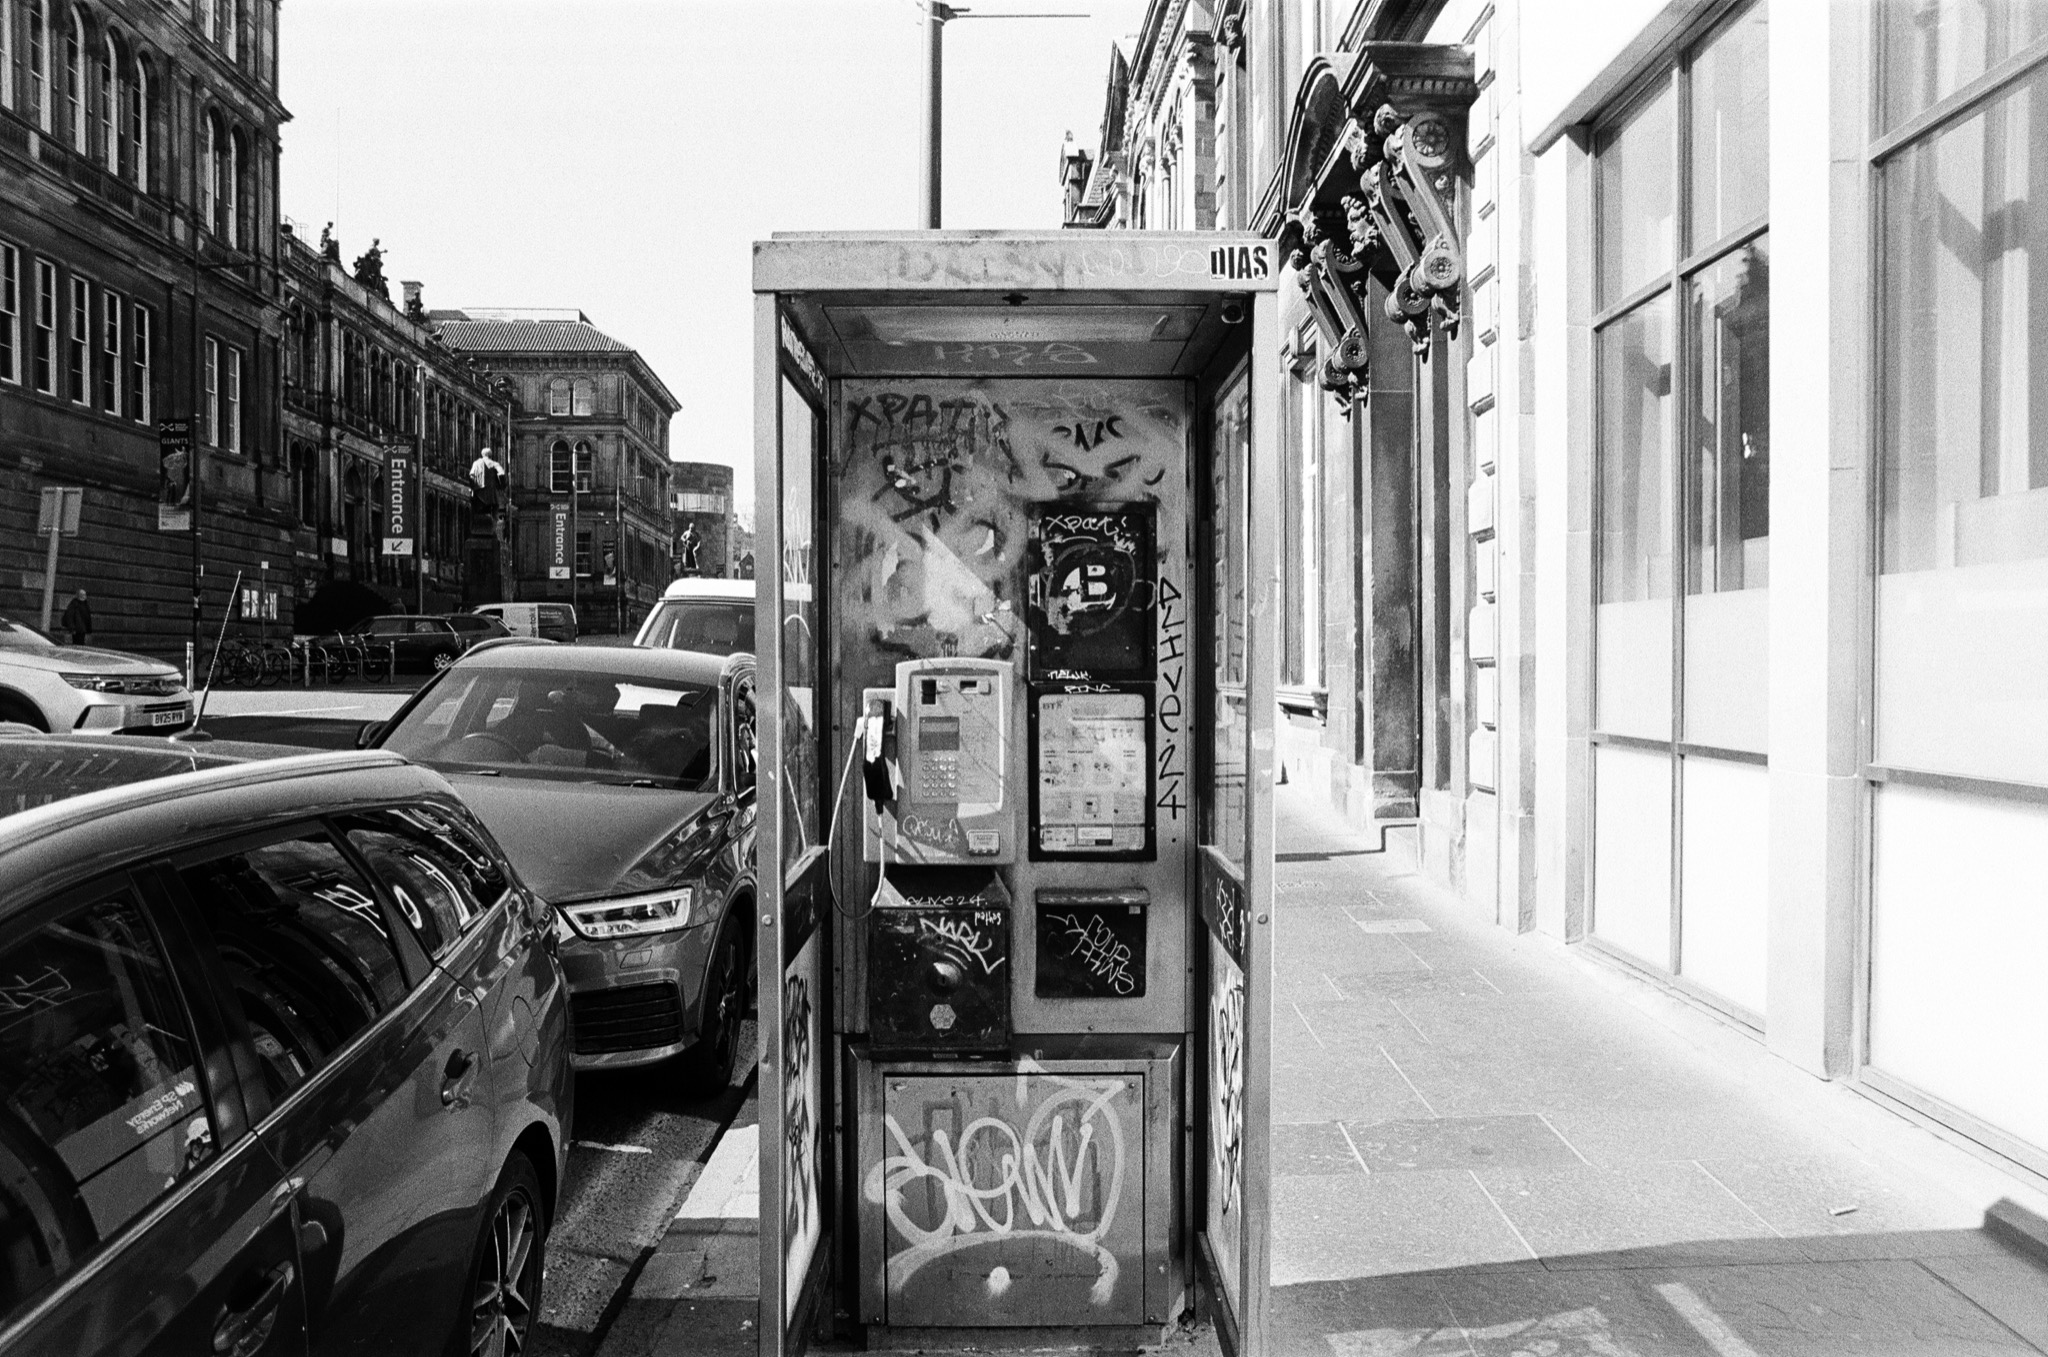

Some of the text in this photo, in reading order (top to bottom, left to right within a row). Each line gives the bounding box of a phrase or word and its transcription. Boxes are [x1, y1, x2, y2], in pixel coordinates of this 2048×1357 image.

[1211, 246, 1268, 280] DIAS
[391, 459, 406, 534] Entrance
[555, 513, 566, 564] Entrance
